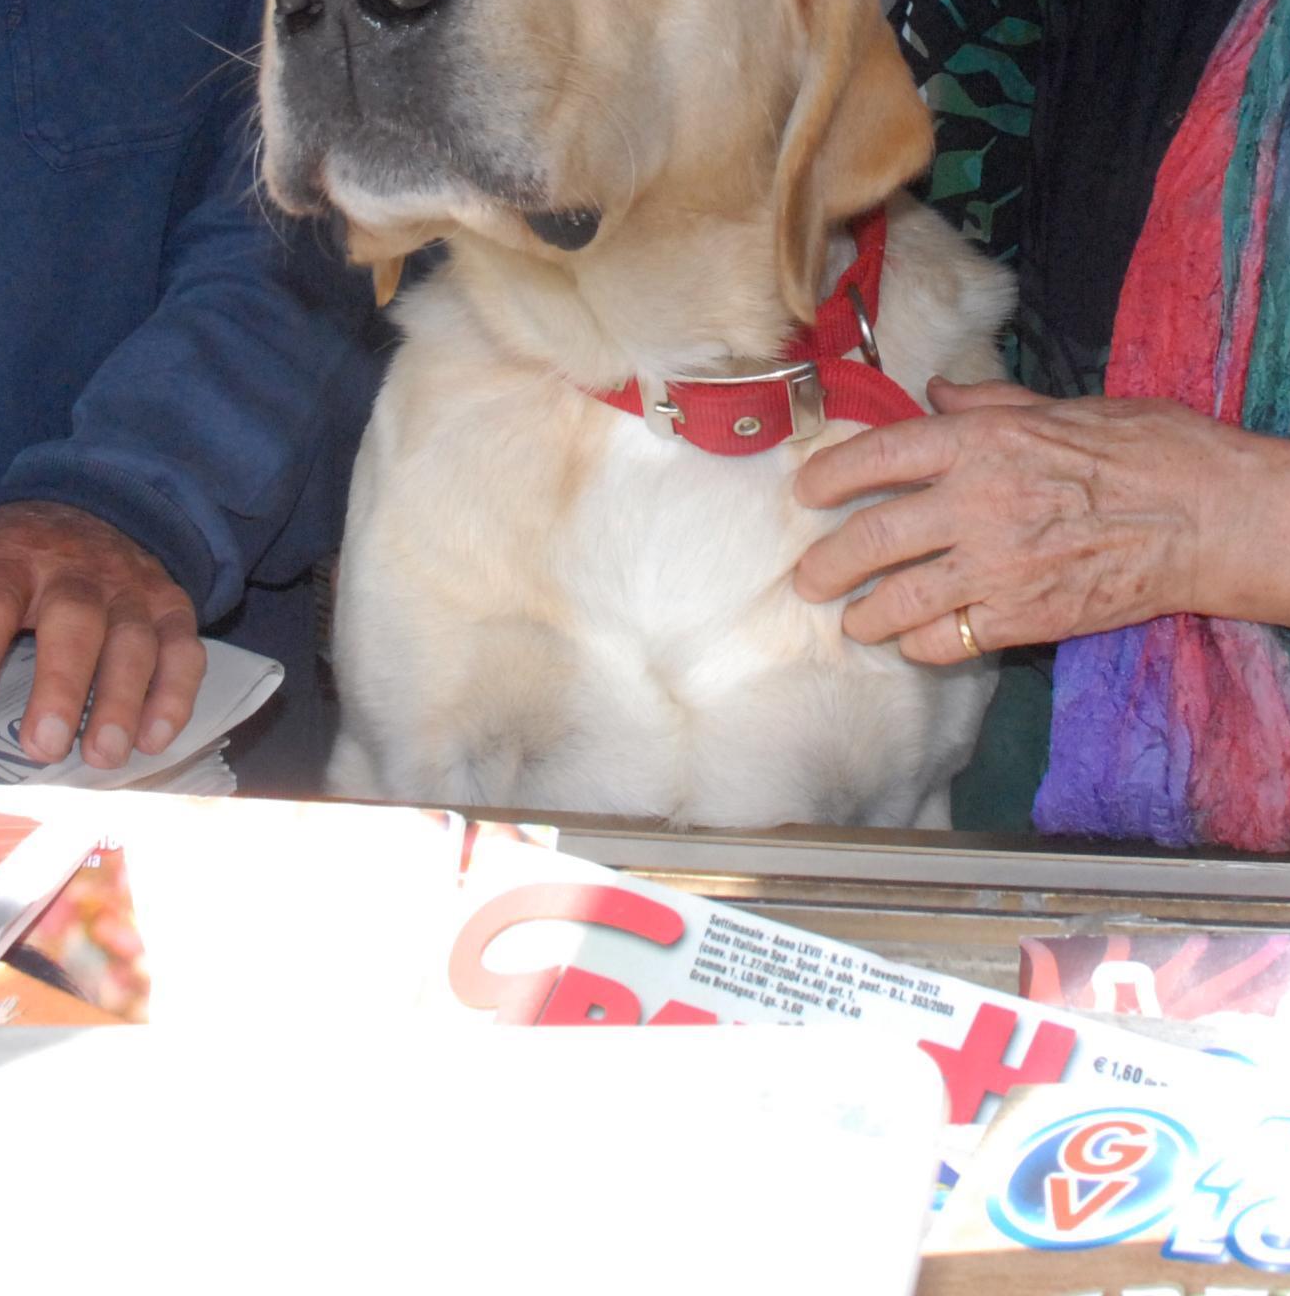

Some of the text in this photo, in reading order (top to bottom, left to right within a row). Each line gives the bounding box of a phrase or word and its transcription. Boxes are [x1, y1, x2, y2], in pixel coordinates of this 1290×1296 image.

[704, 926, 731, 946] Poste
[731, 936, 771, 959] Italiane
[709, 913, 764, 943] Settimanale
[772, 932, 797, 953] Anno
[869, 964, 915, 990] novembre
[917, 978, 942, 997] 2012
[688, 967, 712, 985] Gran
[693, 955, 728, 977] comma
[1092, 1056, 1145, 1086] € 1,60
